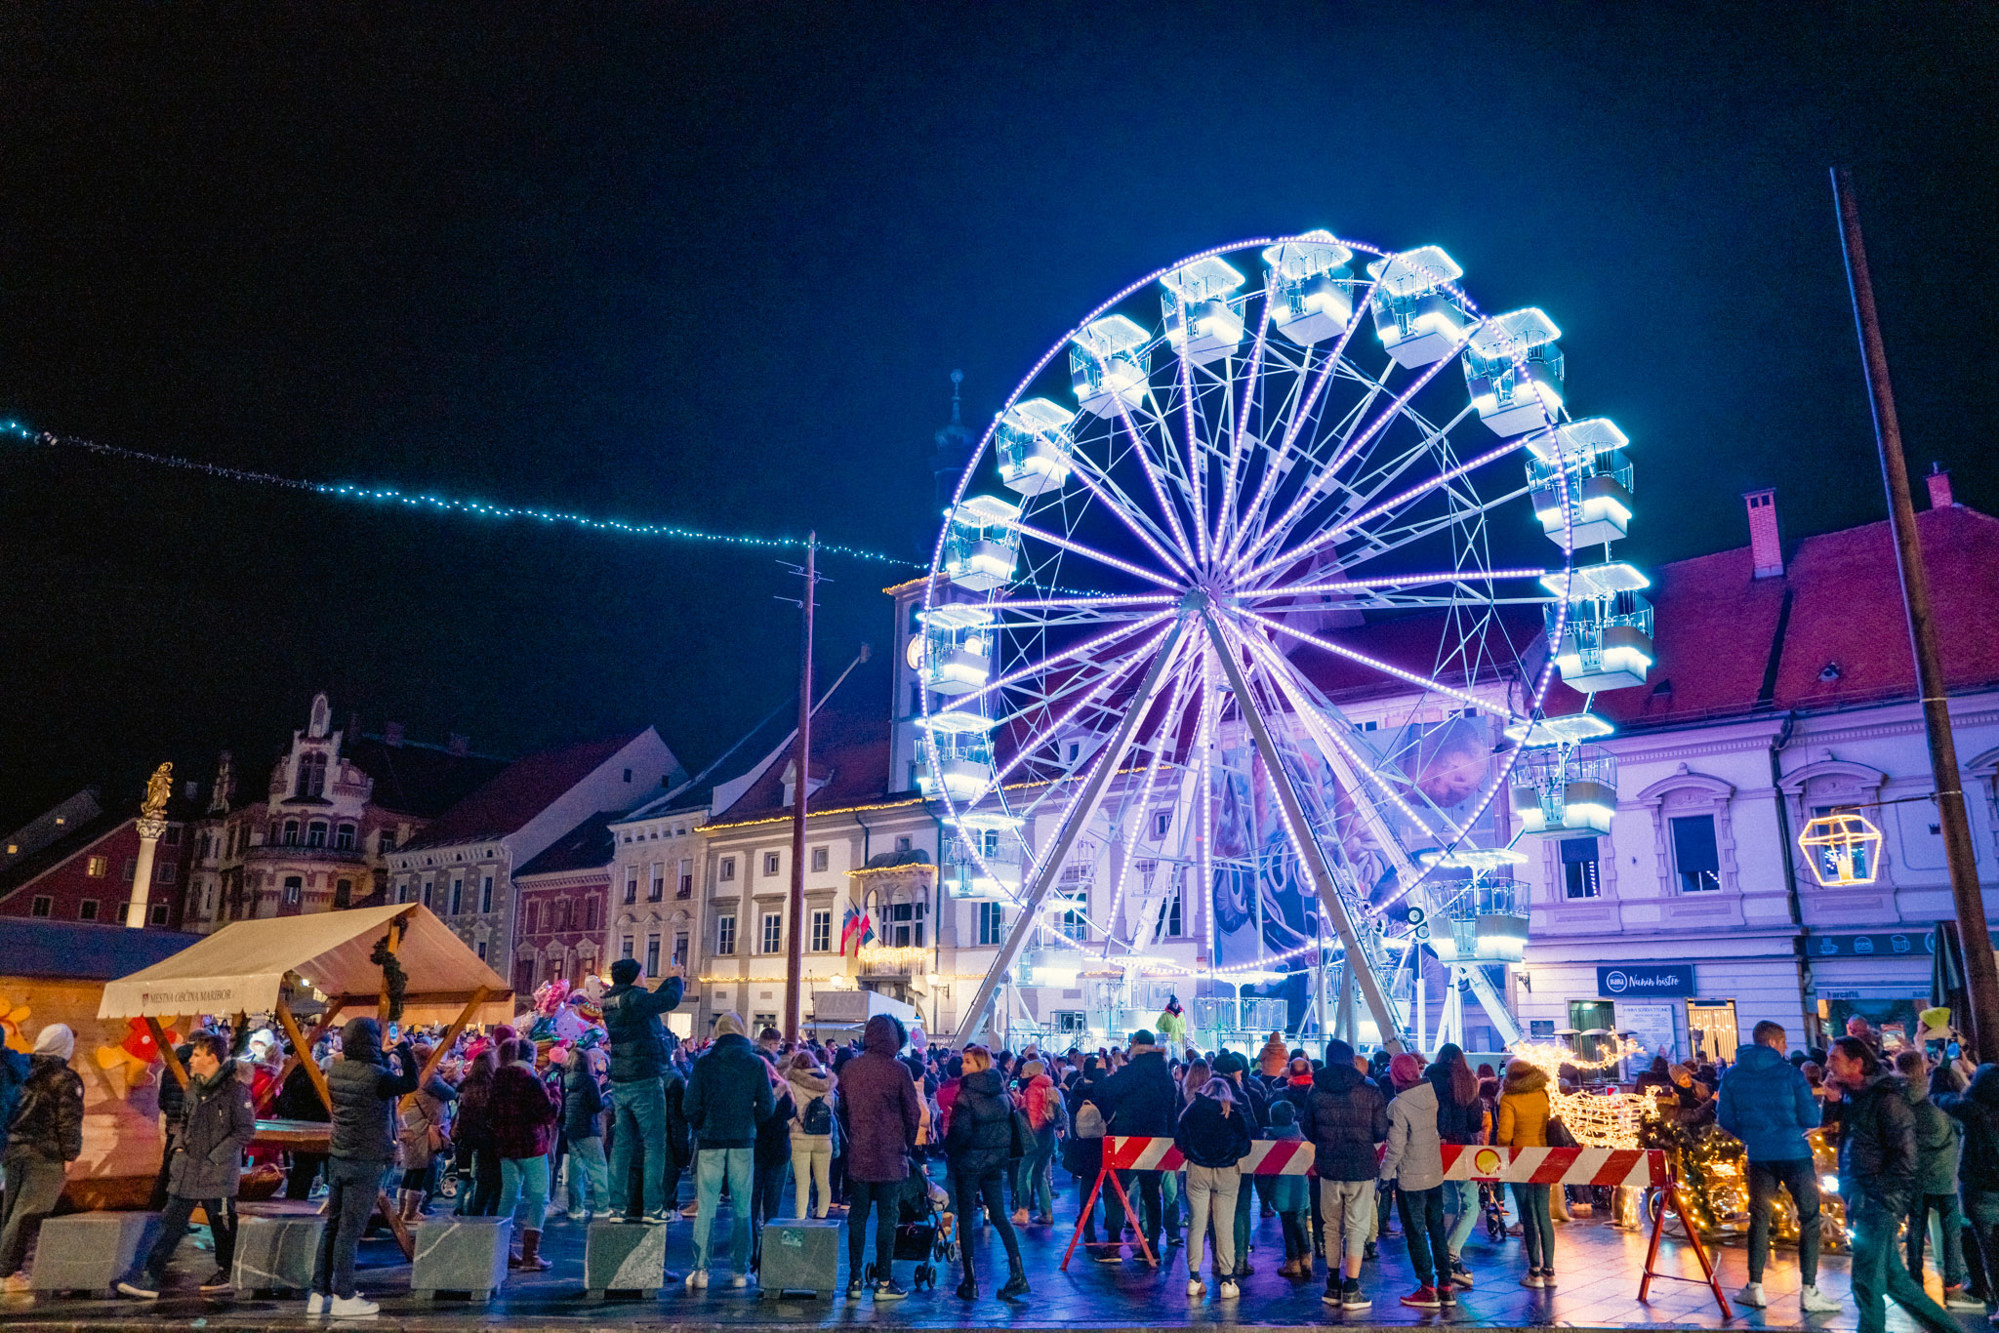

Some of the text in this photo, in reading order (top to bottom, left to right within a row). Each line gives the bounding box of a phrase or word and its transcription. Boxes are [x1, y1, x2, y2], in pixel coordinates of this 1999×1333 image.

[1656, 974, 1680, 987] bistro
[149, 988, 232, 1004] MESTNA OBČINA MARIBOR
[818, 994, 867, 1014] CASSA
